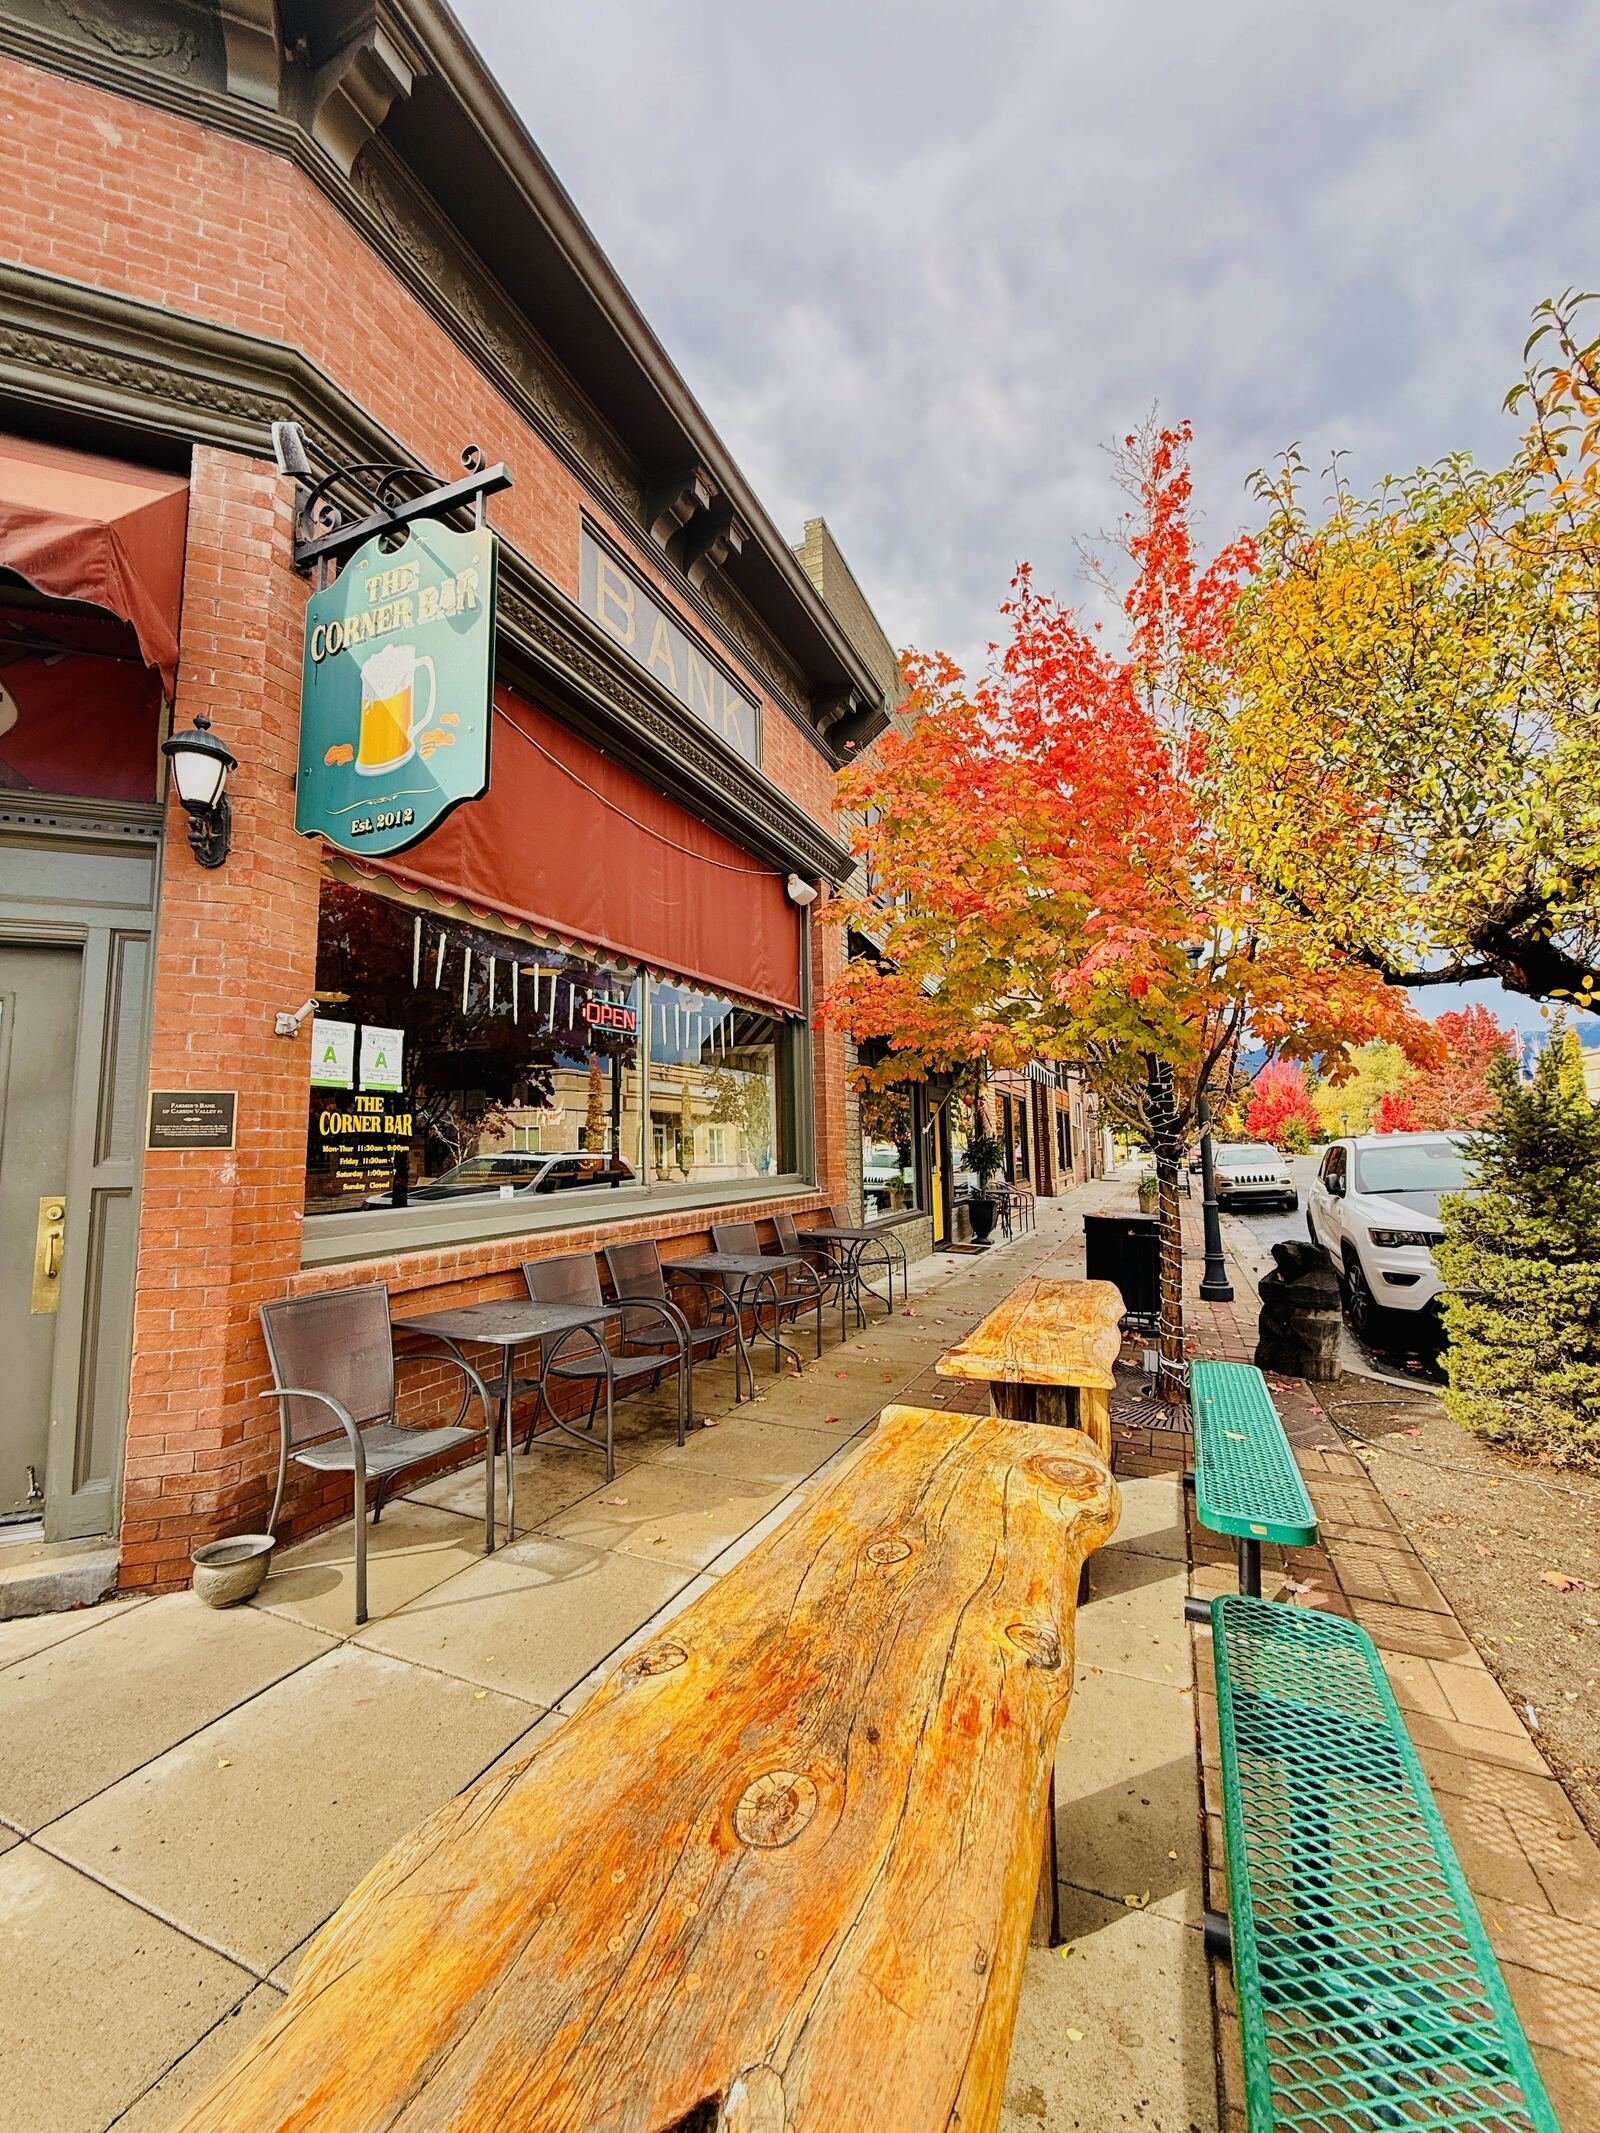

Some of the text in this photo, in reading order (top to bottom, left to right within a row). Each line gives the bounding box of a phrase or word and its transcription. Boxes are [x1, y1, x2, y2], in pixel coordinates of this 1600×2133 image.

[365, 560, 419, 602] THE
[311, 567, 479, 663] CORNER BAR
[597, 552, 744, 751] BANK
[351, 807, 414, 837] Est. 2012
[586, 1002, 636, 1030] OPEN
[323, 1045, 337, 1064] A
[375, 1051, 388, 1068] A
[355, 1096, 385, 1113] THE
[319, 1111, 413, 1136] CORNER BAR
[340, 1158, 359, 1166] Friday
[343, 1181, 389, 1191] Sunday Closed
